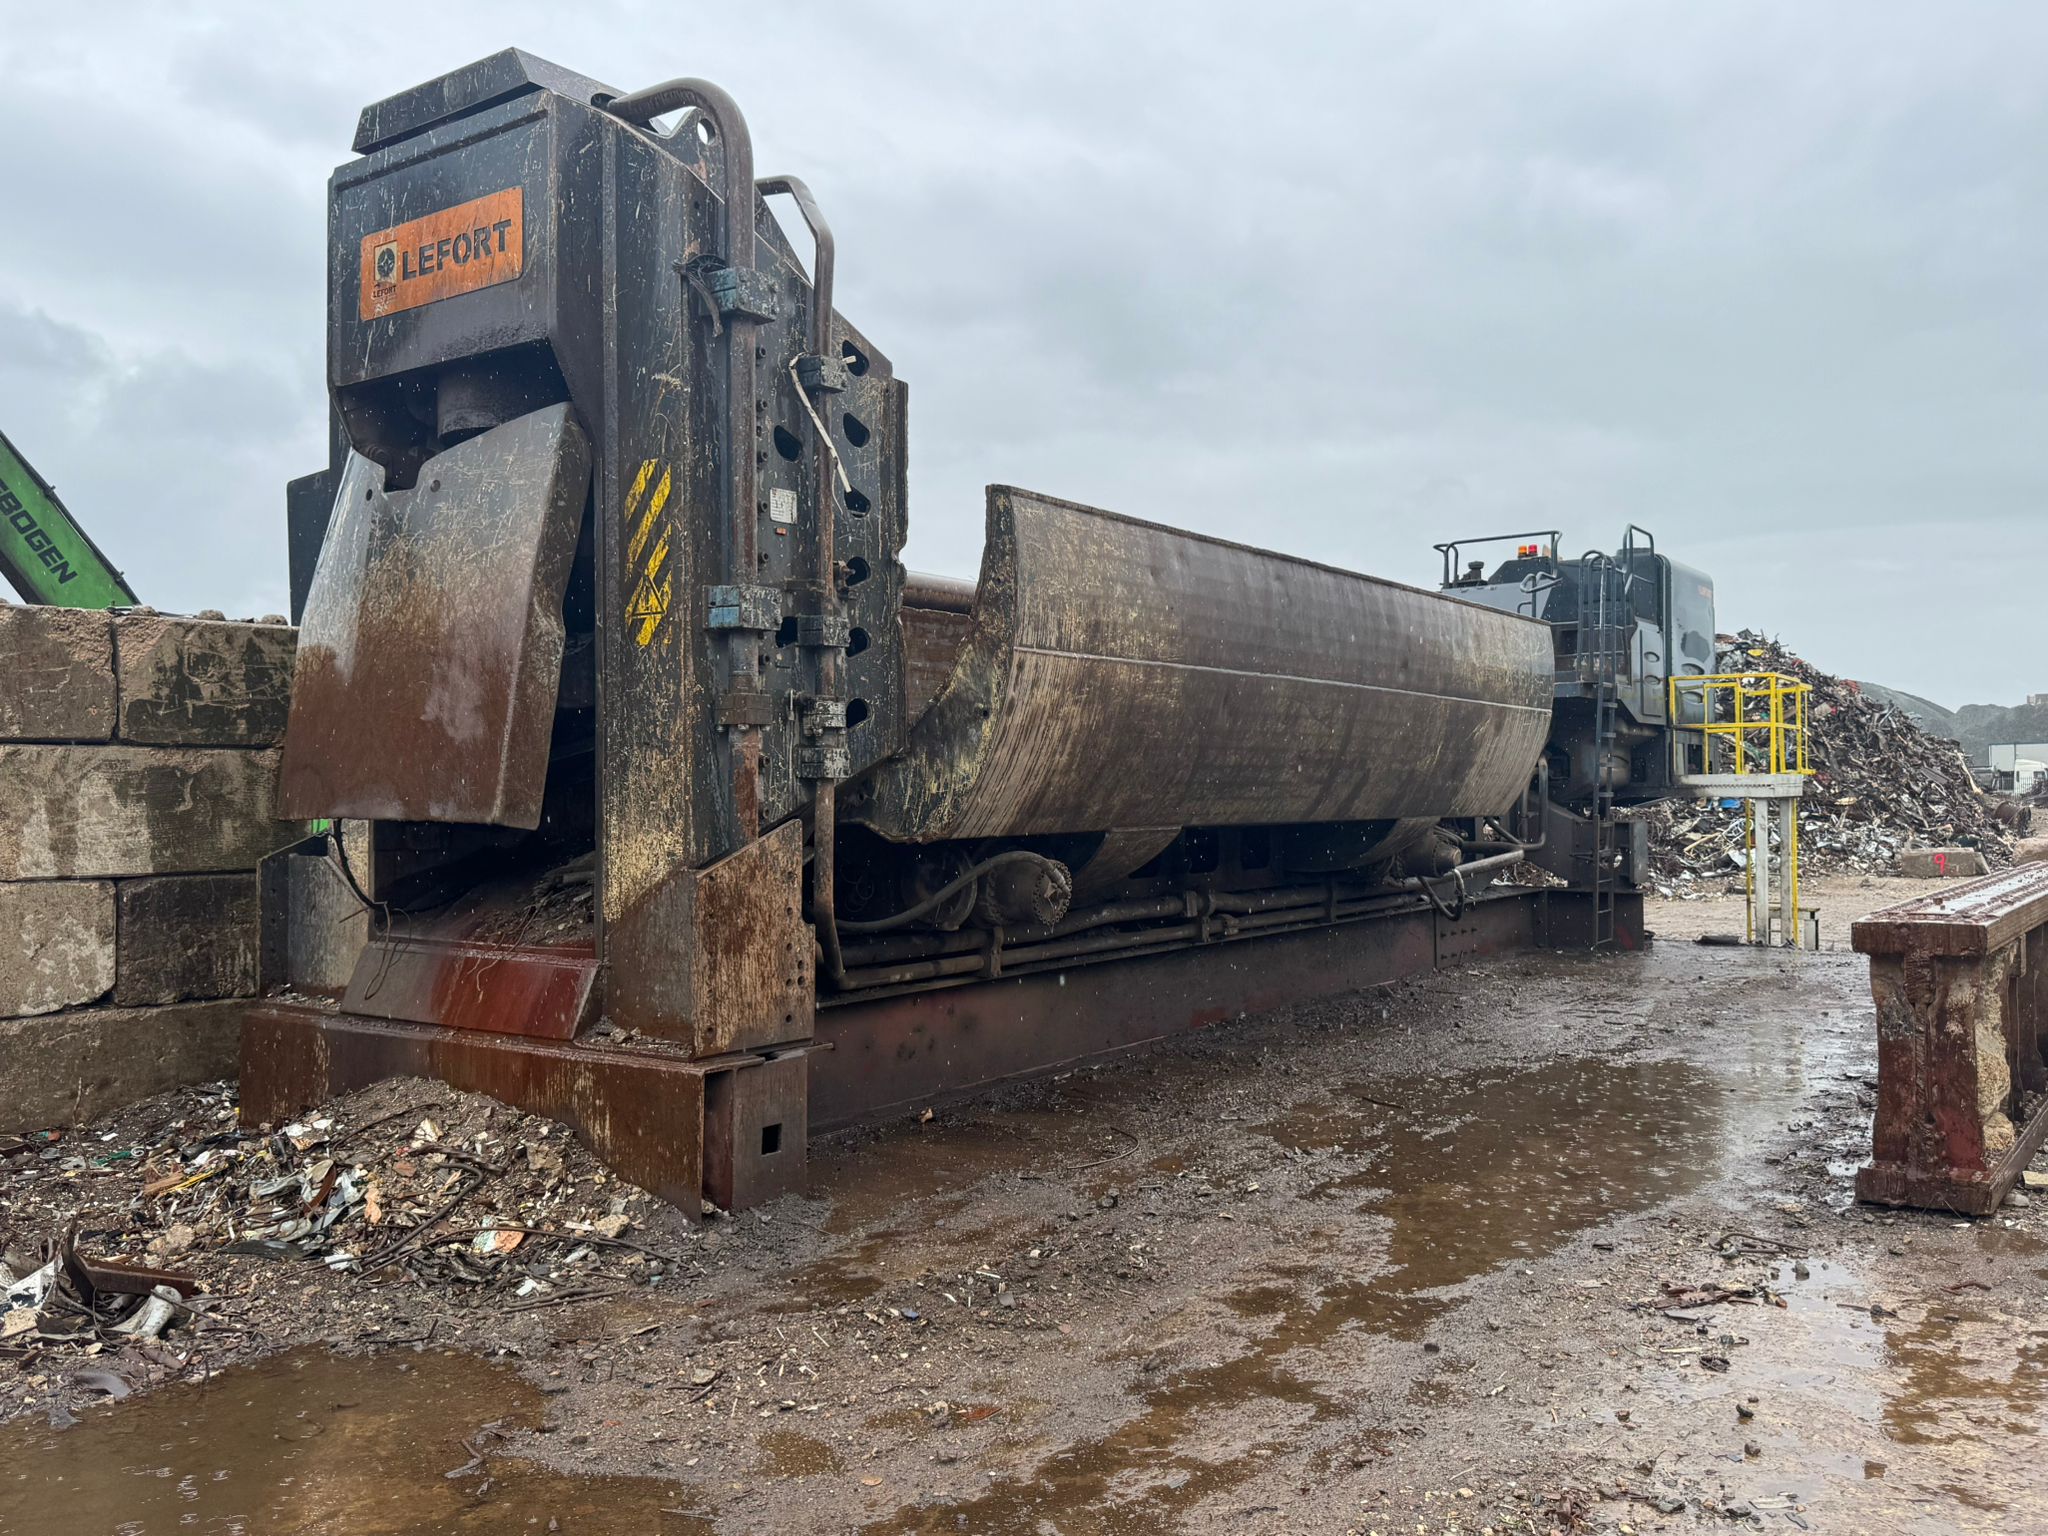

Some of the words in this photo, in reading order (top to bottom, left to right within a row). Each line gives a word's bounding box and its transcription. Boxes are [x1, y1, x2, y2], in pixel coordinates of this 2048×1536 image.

[402, 219, 512, 281] LEFORT
[373, 284, 396, 298] LEFORT
[0, 477, 78, 585] BOGEN
[1935, 853, 1946, 876] 9
